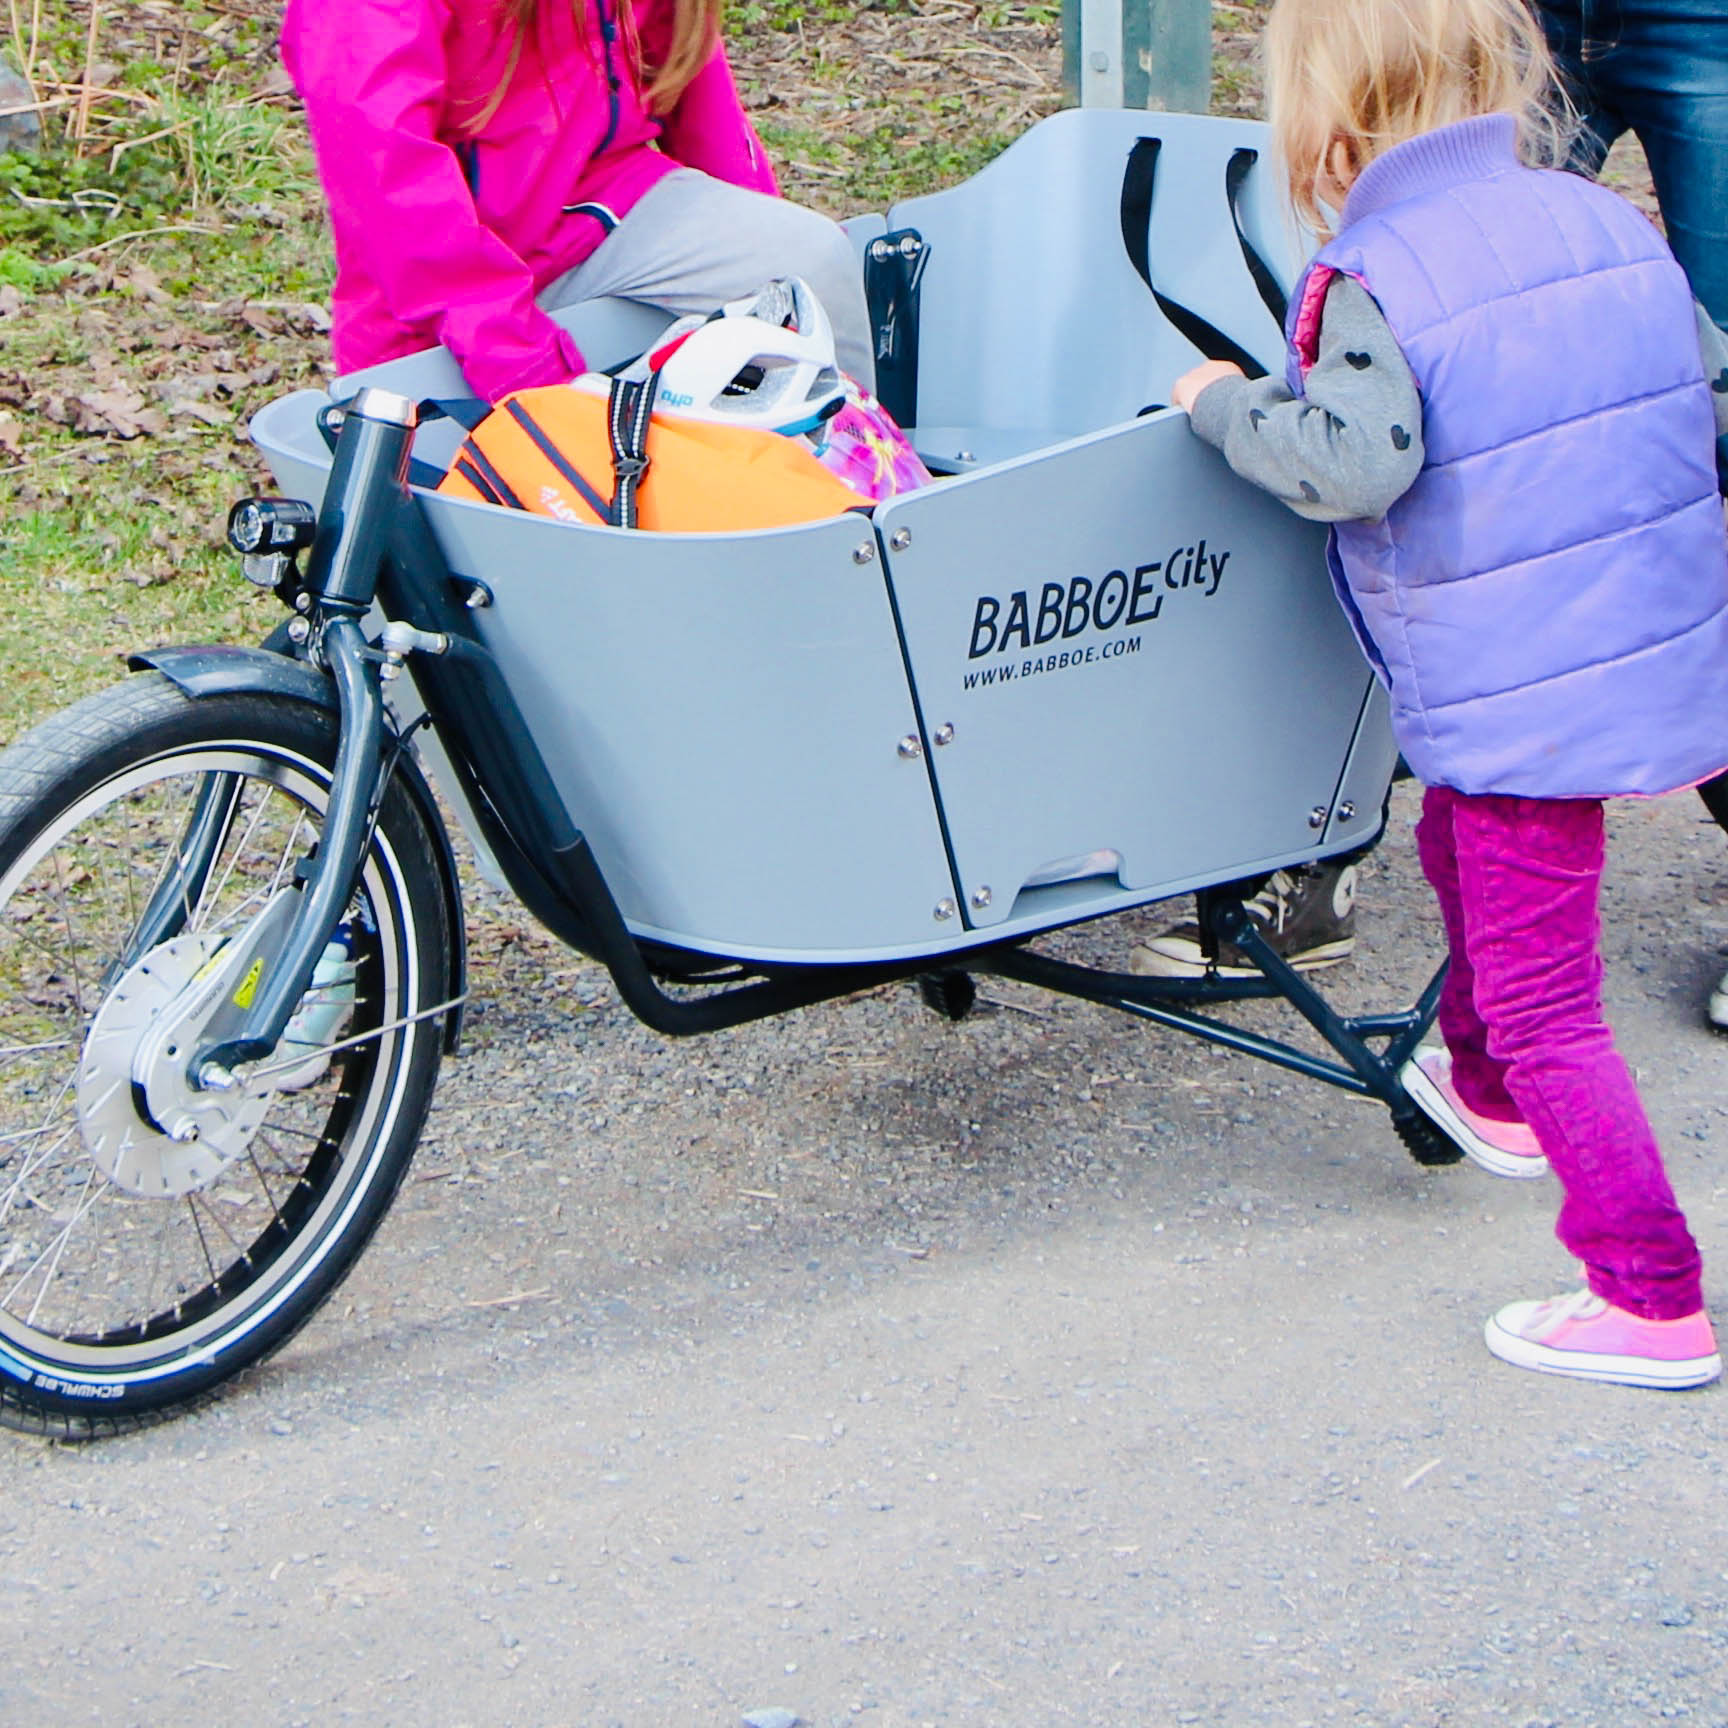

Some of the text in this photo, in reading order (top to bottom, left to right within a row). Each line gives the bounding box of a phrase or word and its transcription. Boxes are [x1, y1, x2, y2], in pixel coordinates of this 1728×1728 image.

[968, 539, 1231, 659] BABBOE City
[963, 636, 1142, 690] WWW.BABBOE.COM
[34, 1374, 126, 1399] SCHWALBE
